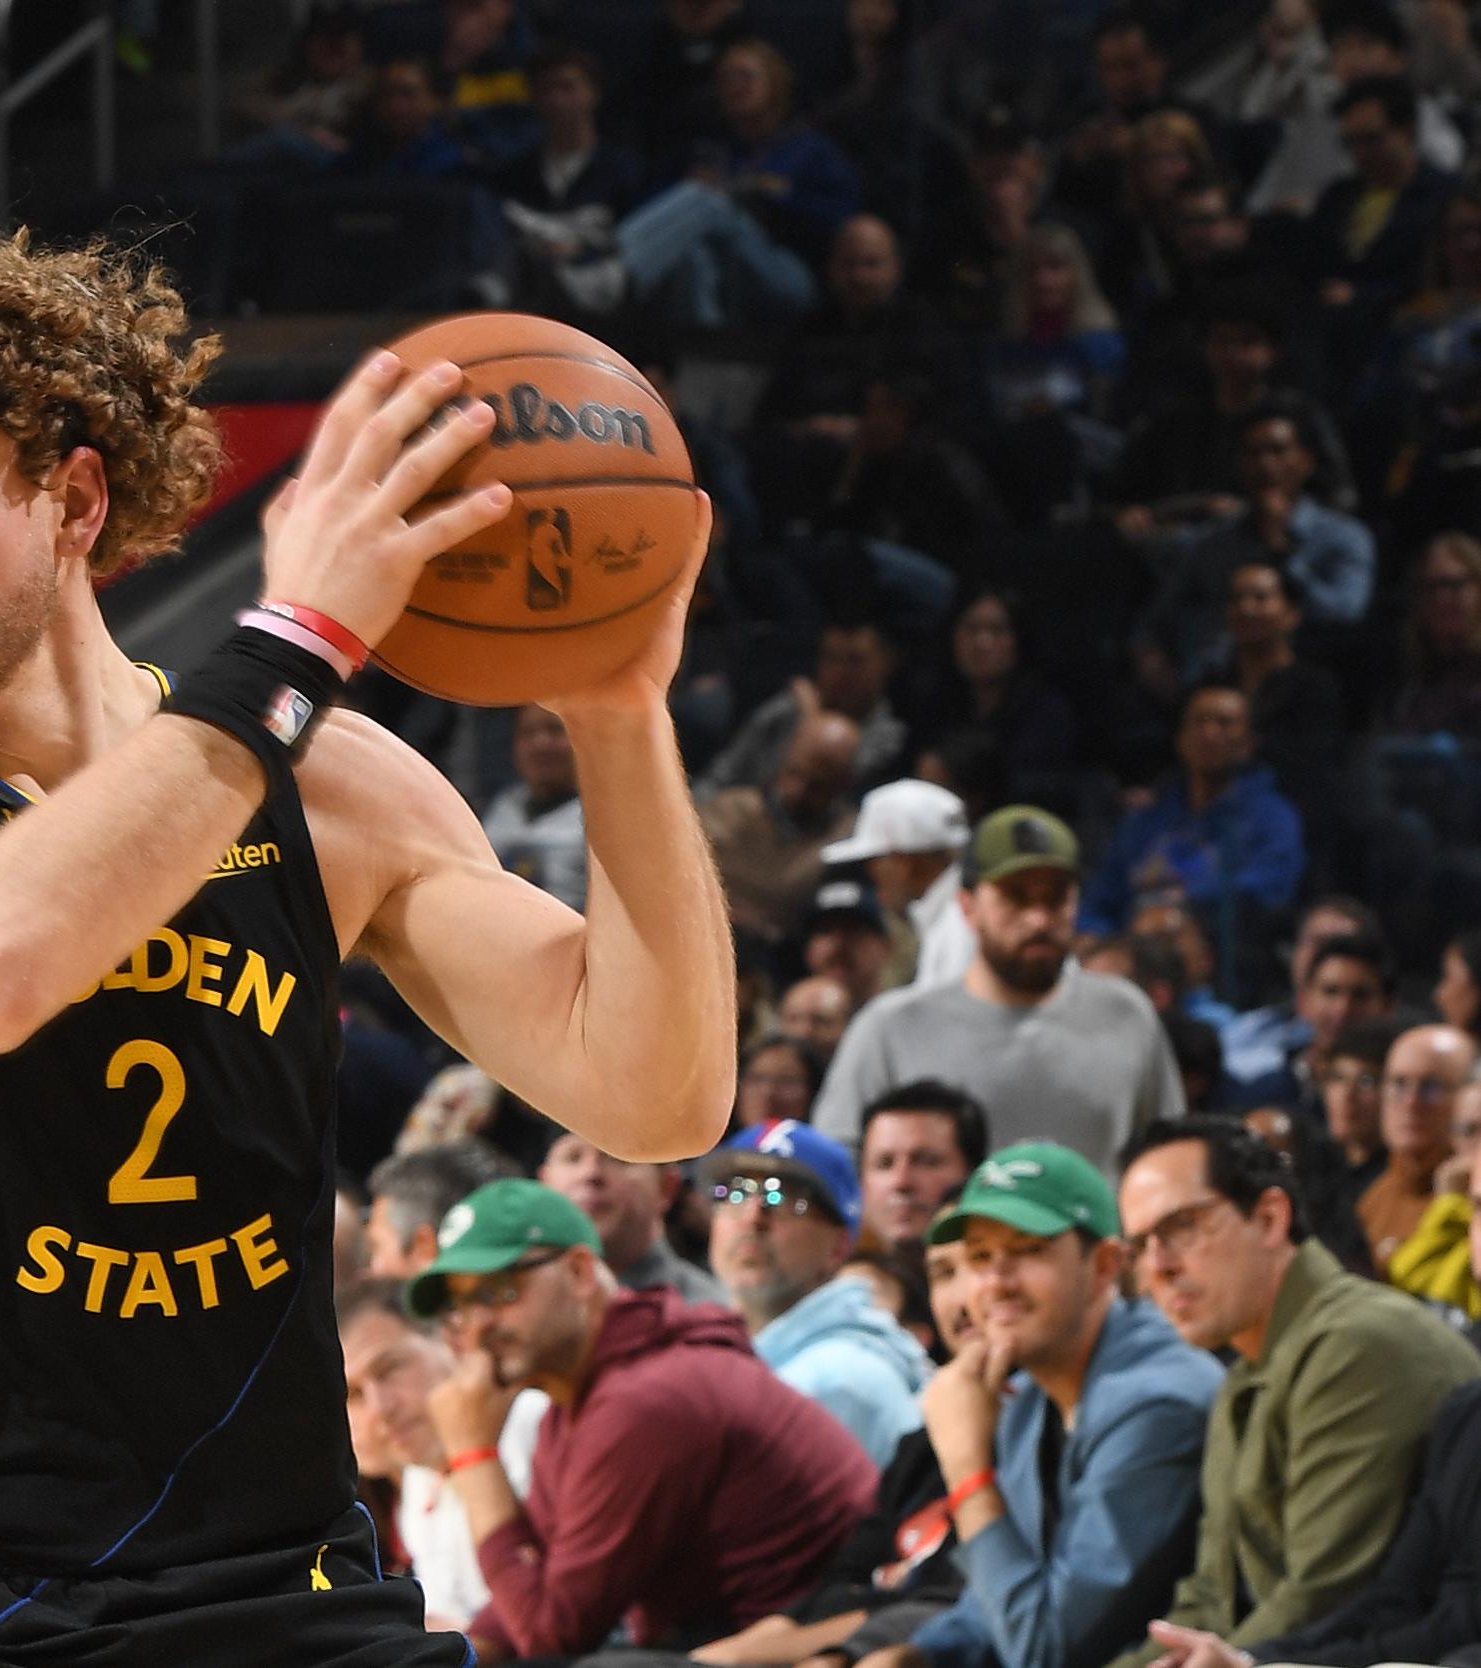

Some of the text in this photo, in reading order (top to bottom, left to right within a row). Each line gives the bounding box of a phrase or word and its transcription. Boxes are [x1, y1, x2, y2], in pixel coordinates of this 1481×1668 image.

[212, 841, 282, 870] uten
[106, 1039, 197, 1204] 2
[16, 1213, 289, 1318] STATE
